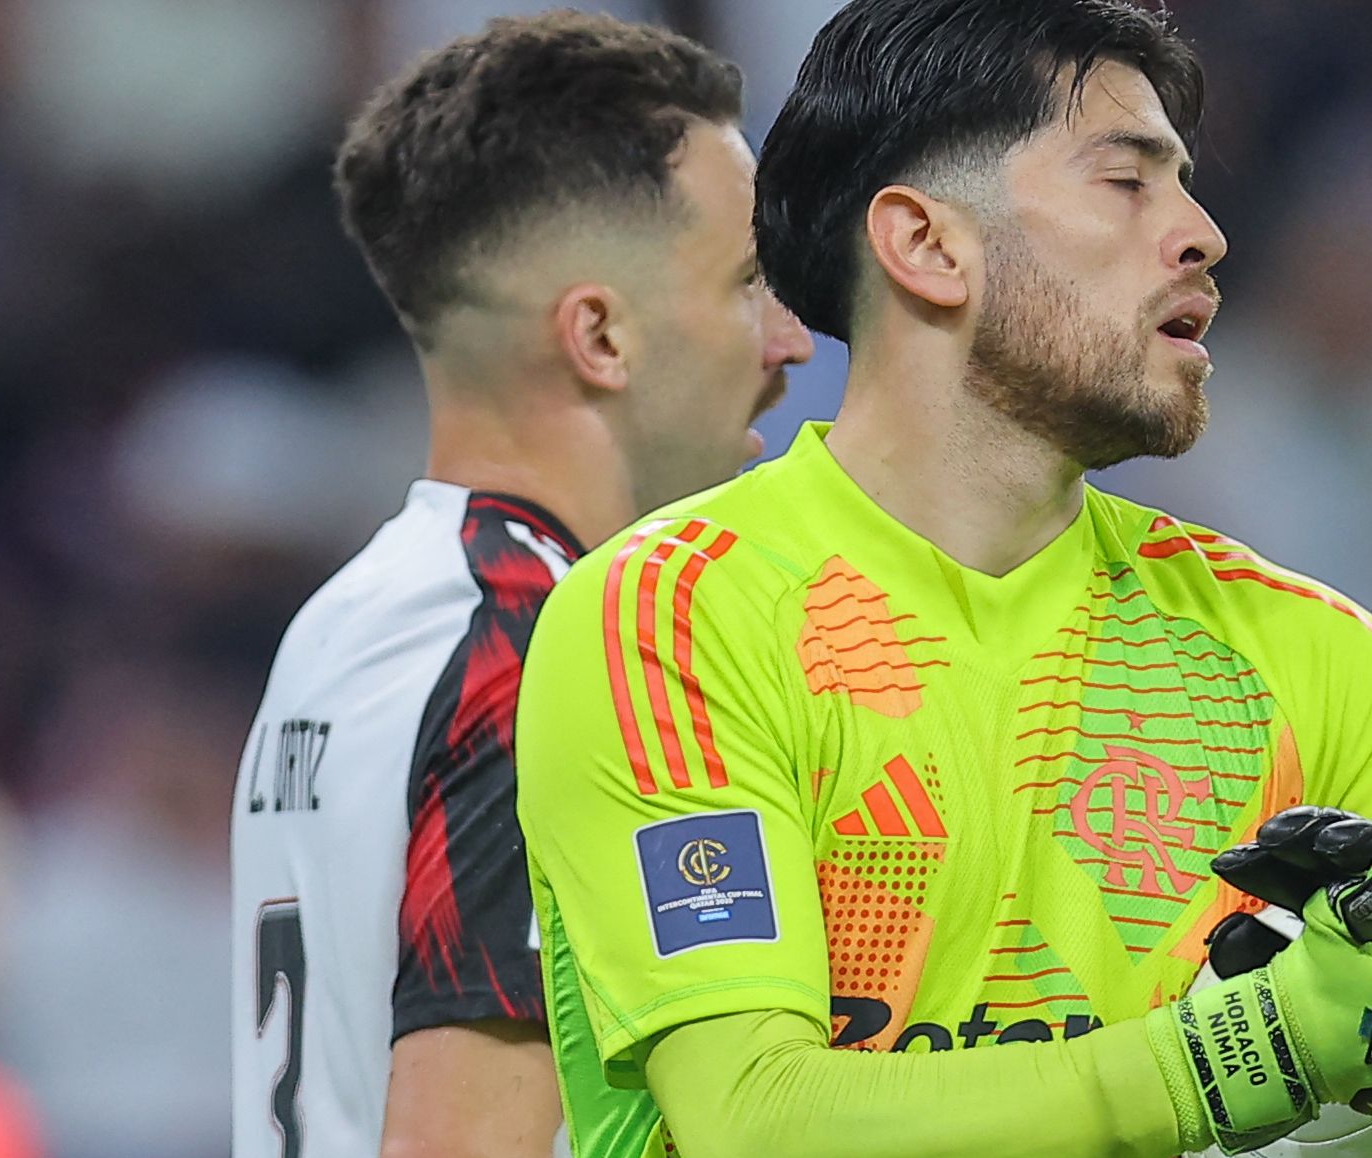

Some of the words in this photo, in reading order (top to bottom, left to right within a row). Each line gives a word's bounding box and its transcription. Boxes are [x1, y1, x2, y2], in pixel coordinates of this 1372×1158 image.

[742, 890, 764, 898] FINAL
[1208, 1012, 1241, 1079] NIMIA
[1223, 991, 1268, 1086] HORACIO
